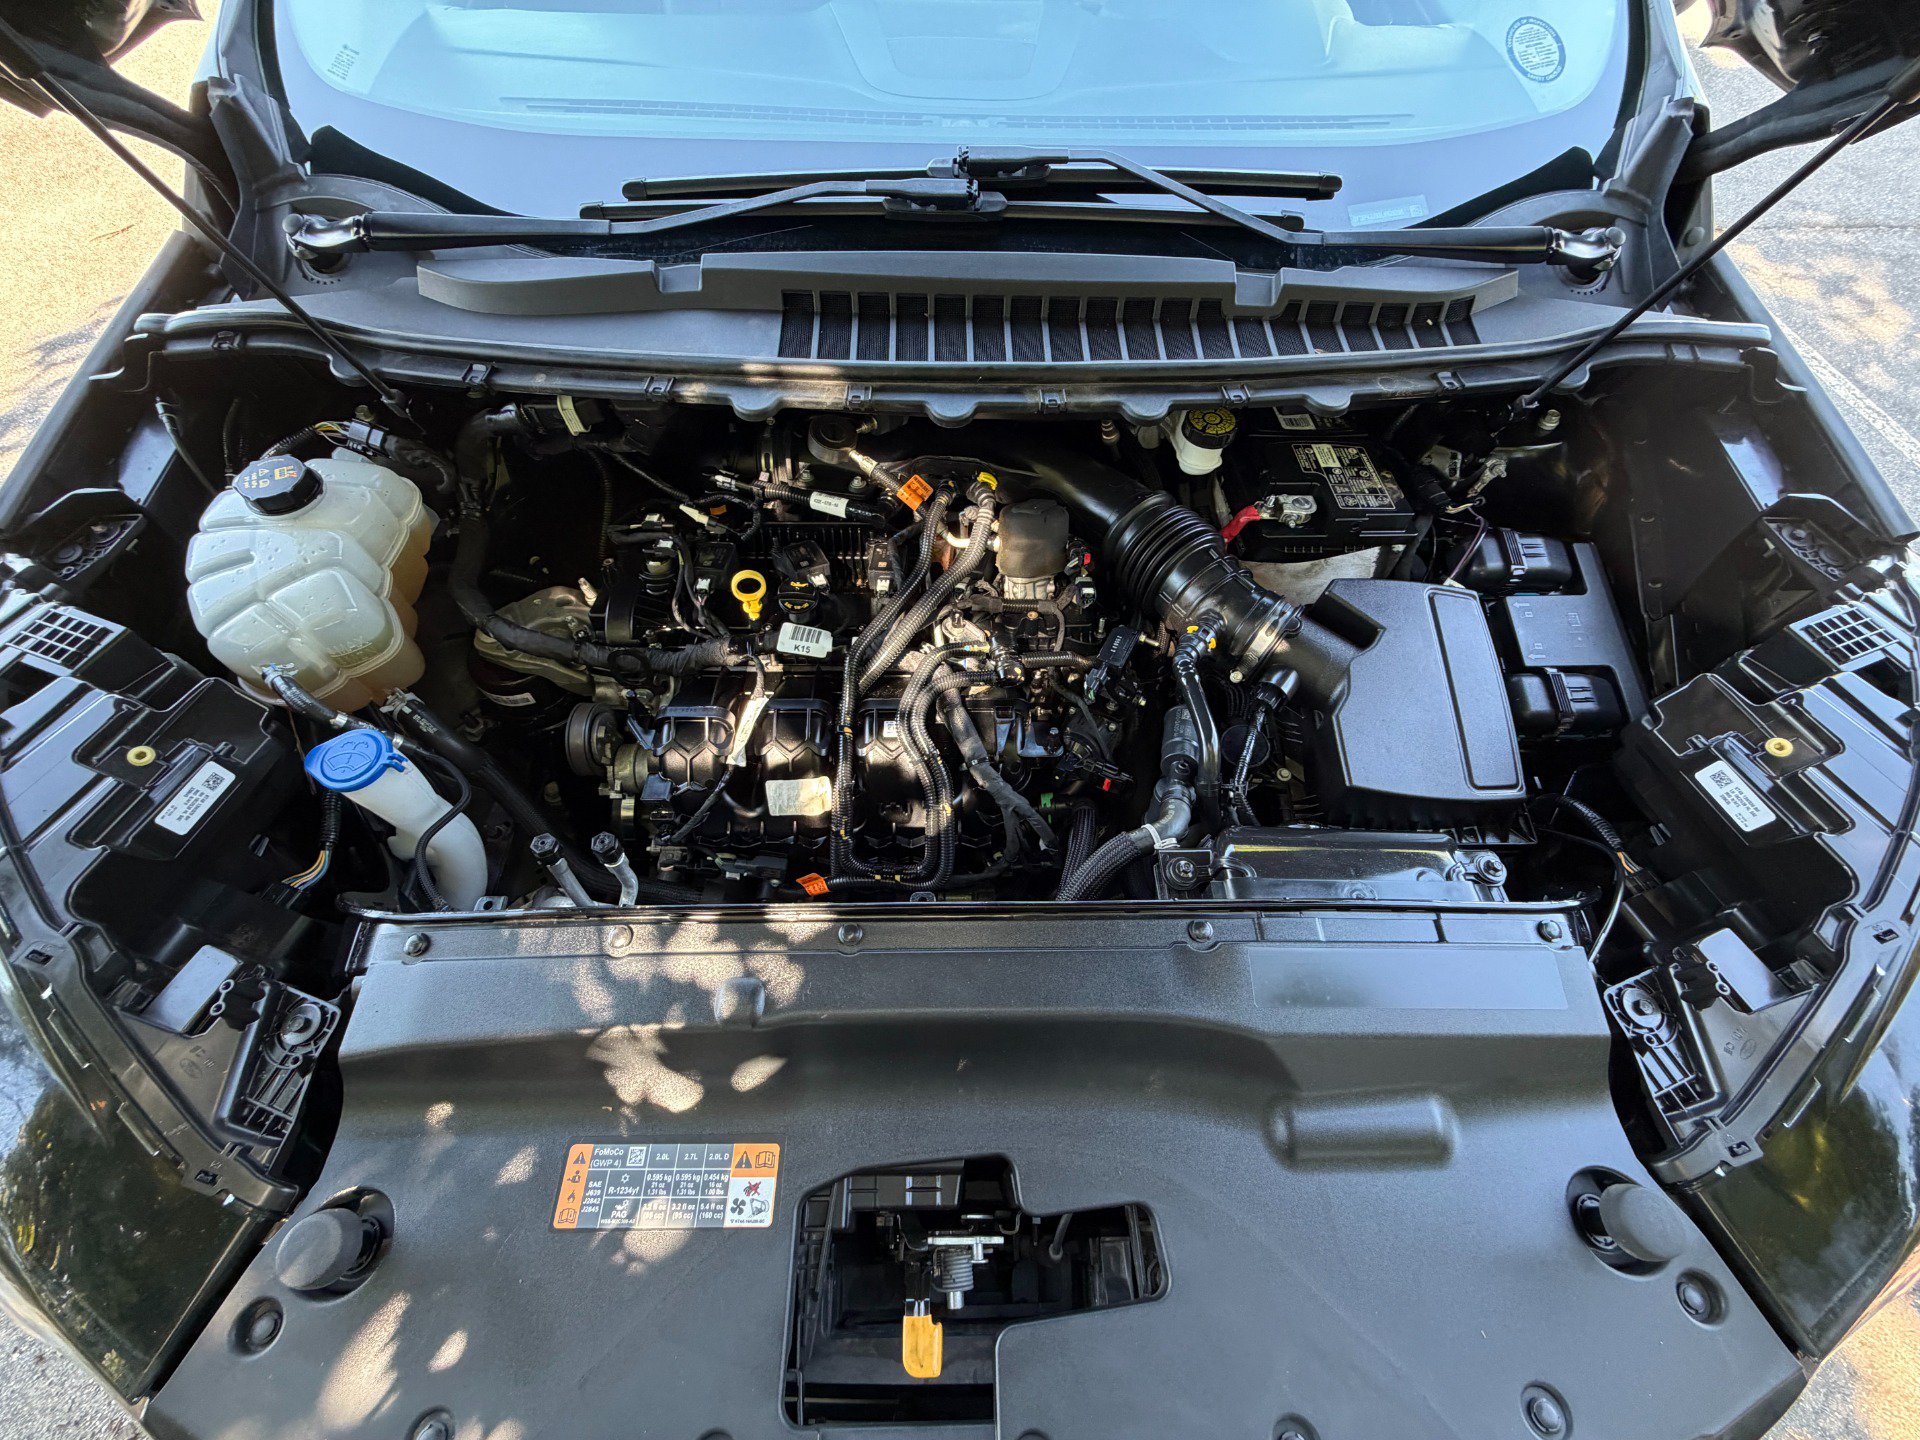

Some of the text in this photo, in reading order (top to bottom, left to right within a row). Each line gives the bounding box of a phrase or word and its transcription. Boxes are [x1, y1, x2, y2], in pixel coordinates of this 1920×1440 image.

[794, 645, 811, 654] K15
[590, 1159, 621, 1167] (GWP 4)
[664, 1174, 672, 1183] kg
[693, 1174, 700, 1183] kg
[721, 1174, 729, 1183] kg
[608, 1187, 639, 1195] R-1234yf
